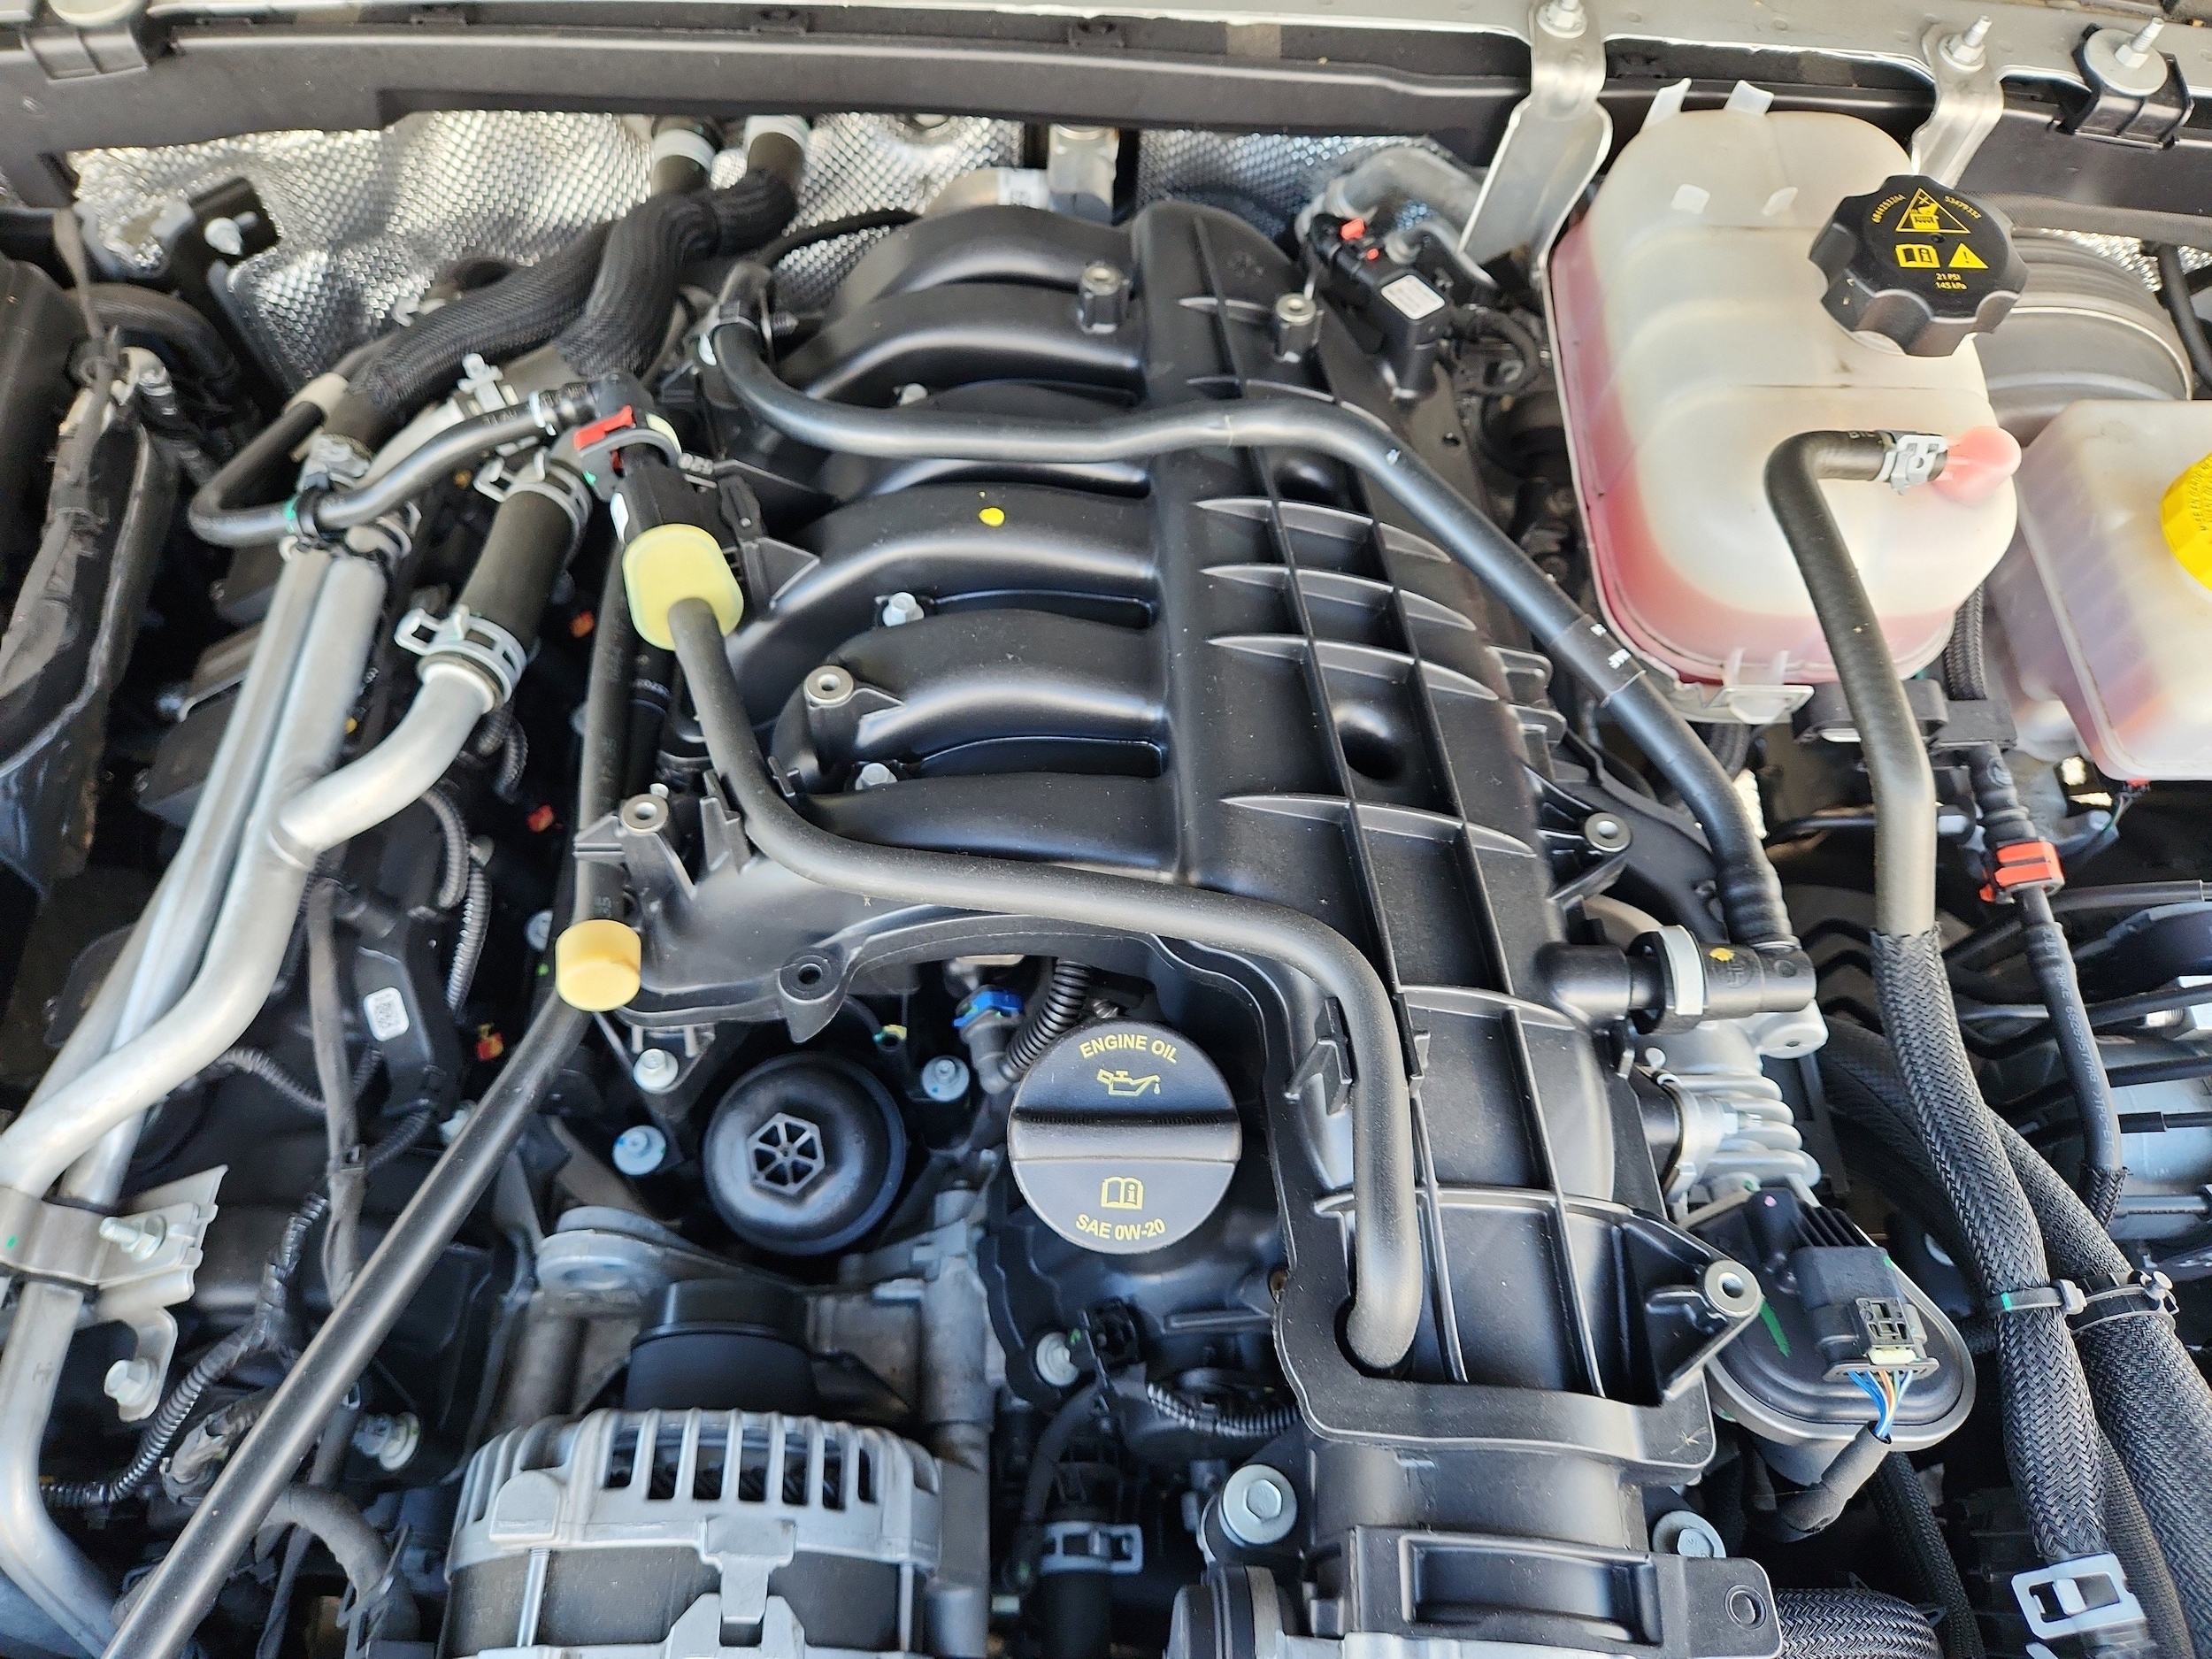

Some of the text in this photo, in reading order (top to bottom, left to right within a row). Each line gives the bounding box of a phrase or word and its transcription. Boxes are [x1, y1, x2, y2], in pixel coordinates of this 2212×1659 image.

[1947, 273, 1962, 281] PSI
[1079, 1033, 1178, 1064] ENGINE OIL
[2065, 1005, 2100, 1082] 68289577AG
[1076, 1213, 1165, 1240] SAE 0W-20
